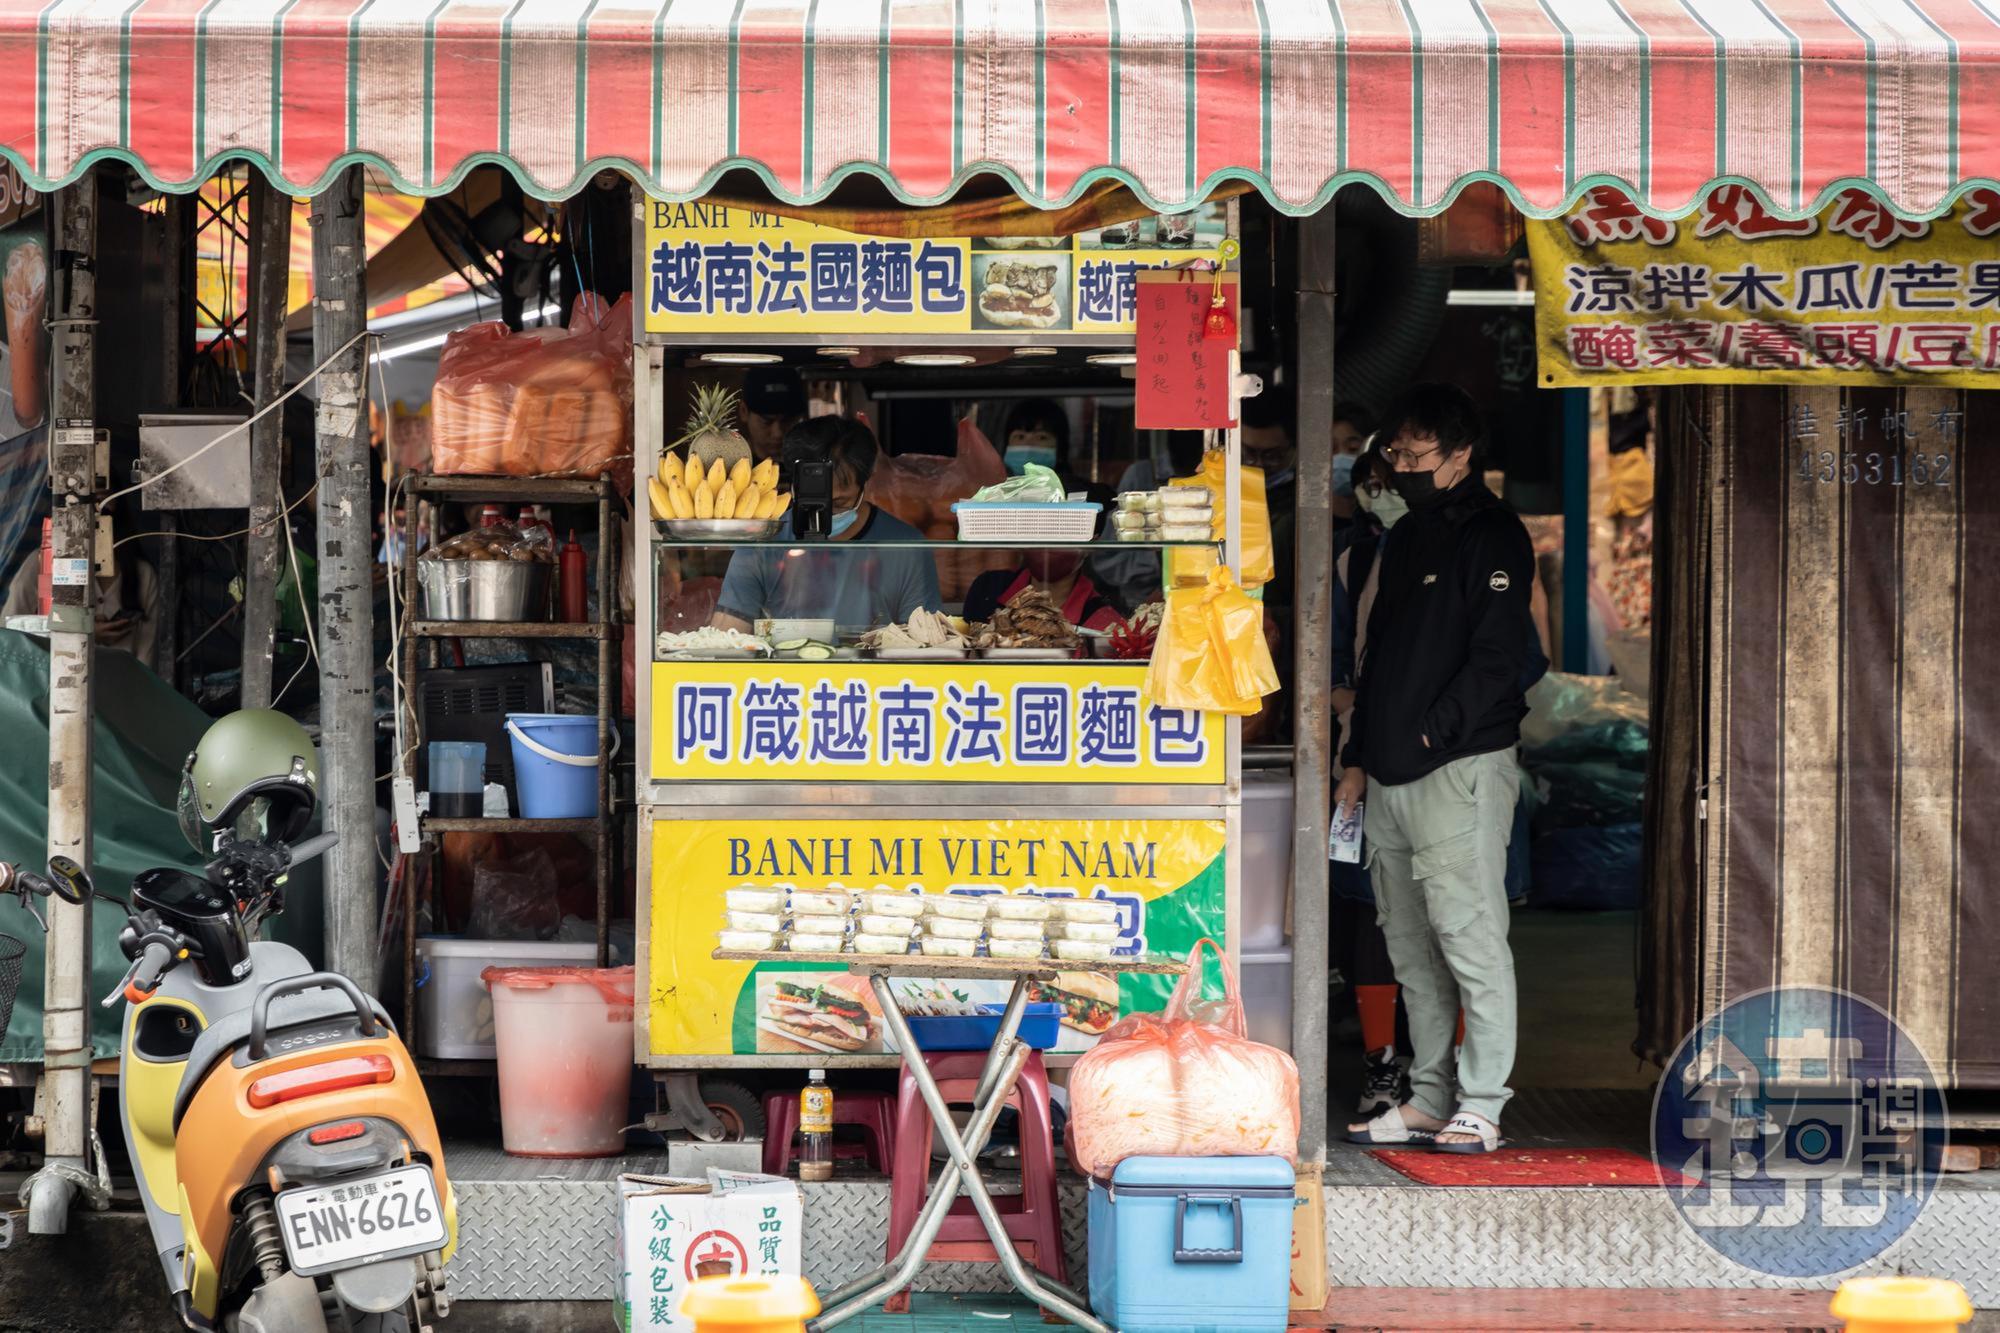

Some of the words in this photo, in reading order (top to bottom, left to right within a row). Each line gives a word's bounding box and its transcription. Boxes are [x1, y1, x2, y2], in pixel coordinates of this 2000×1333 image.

[653, 201, 730, 229] BANH
[651, 240, 965, 314] 越南法國麵包
[1571, 323, 2000, 369] 醃菜/蕎頭/豆
[1797, 450, 1951, 486] 4353162
[678, 682, 1204, 763] 阿箴越南法國麵包
[728, 837, 852, 876] BANH
[869, 838, 924, 876] MI
[938, 838, 1045, 877] VIET
[1060, 840, 1158, 879] NAM
[331, 1182, 378, 1203] 電動車
[648, 1204, 675, 1325] 分級包裝
